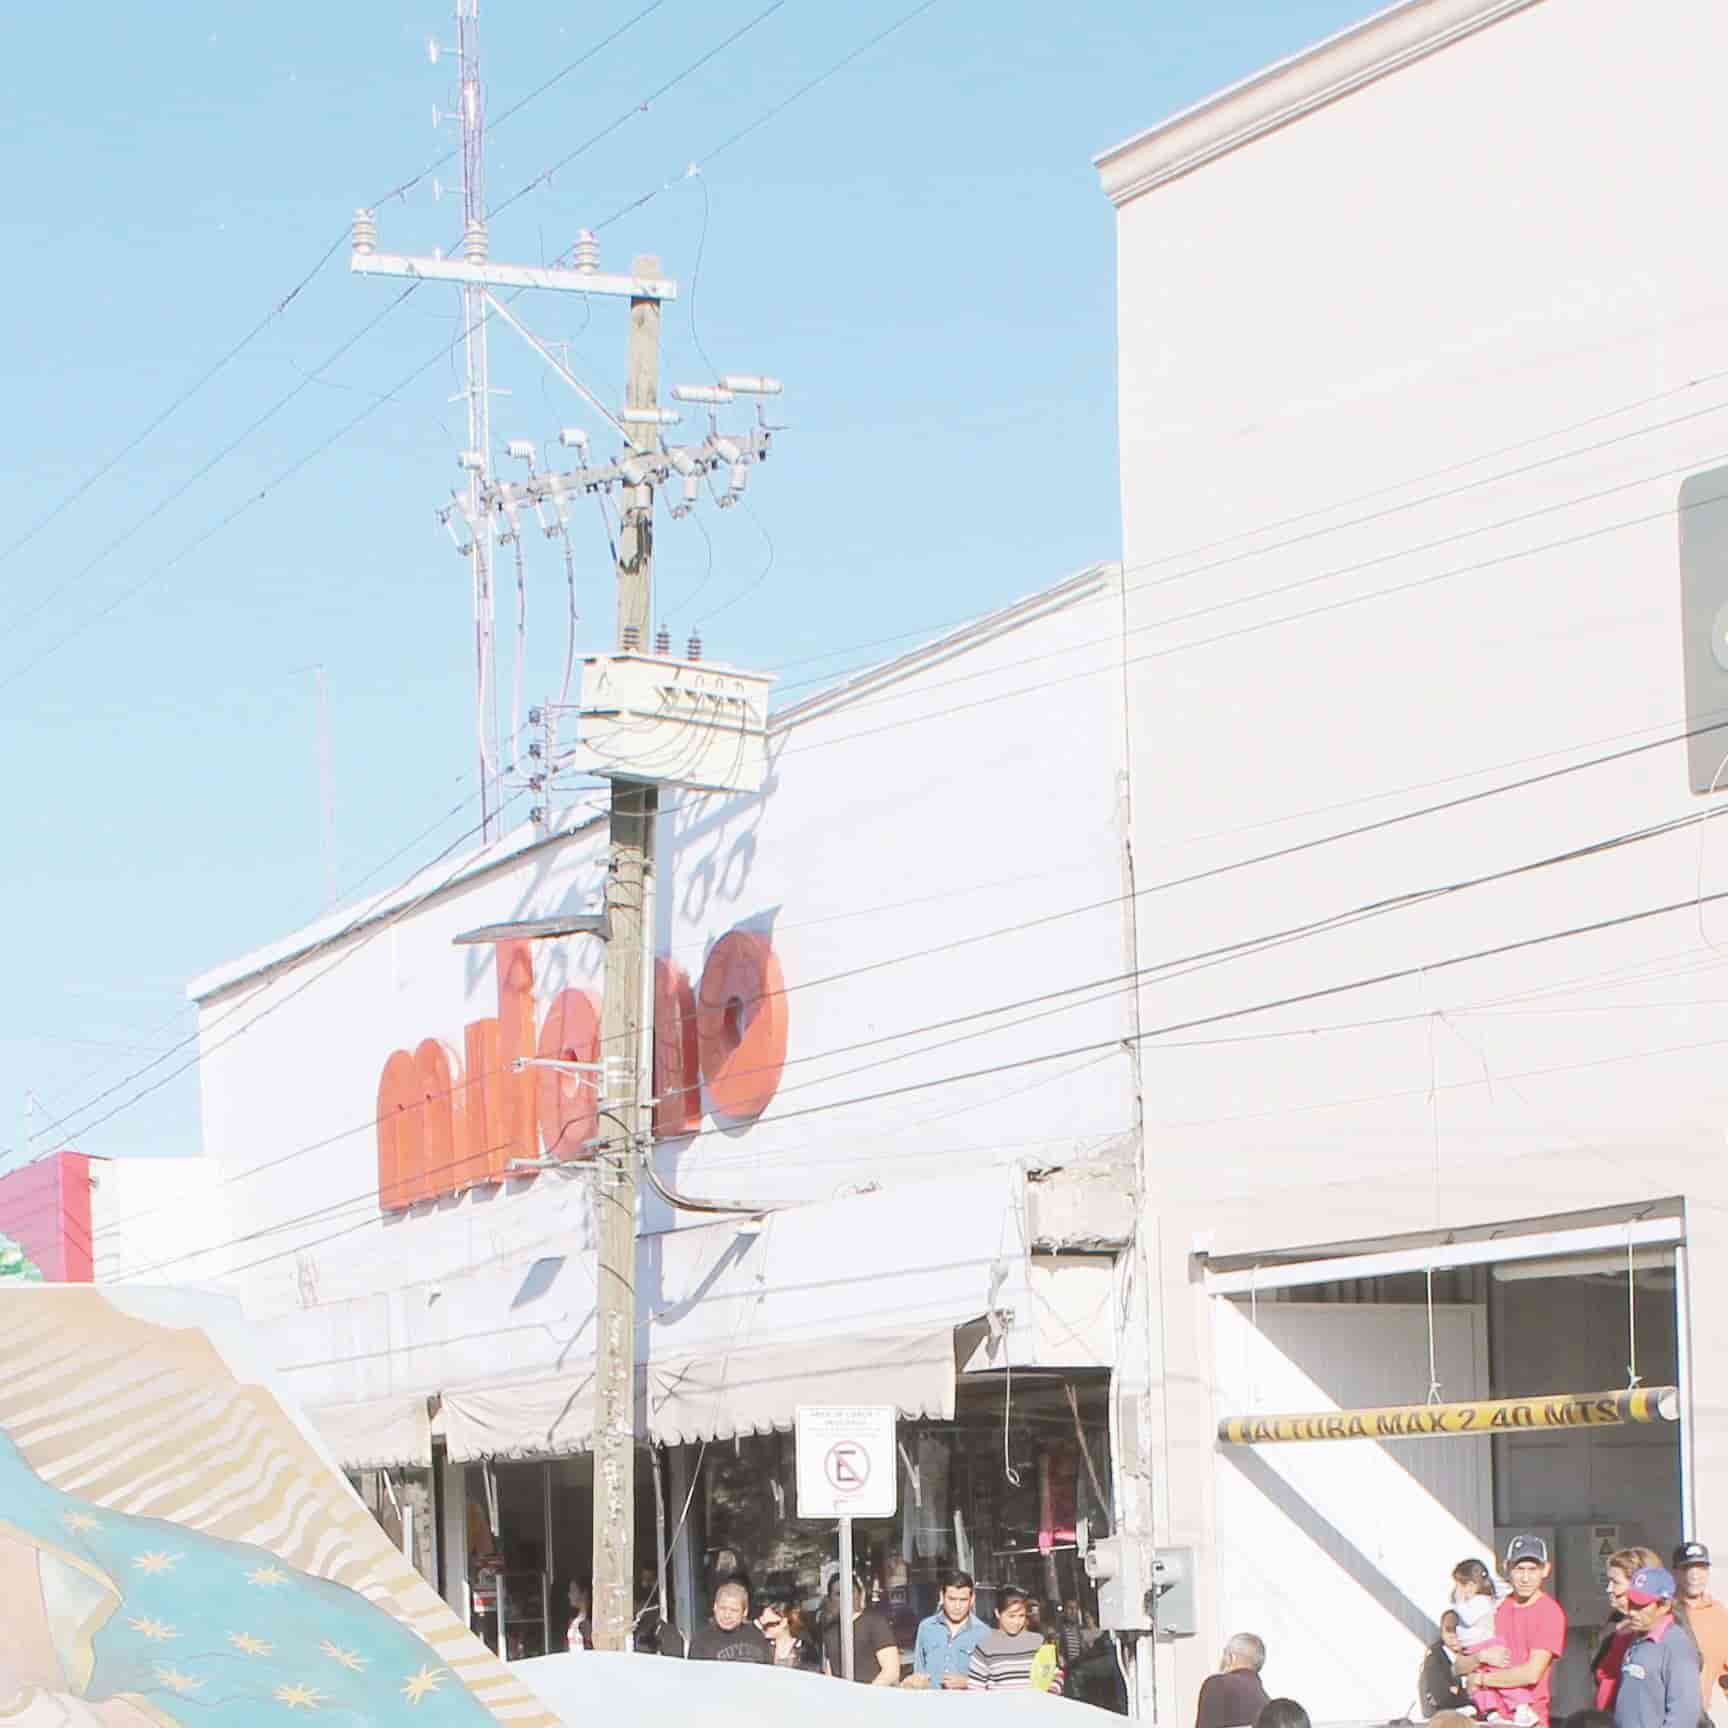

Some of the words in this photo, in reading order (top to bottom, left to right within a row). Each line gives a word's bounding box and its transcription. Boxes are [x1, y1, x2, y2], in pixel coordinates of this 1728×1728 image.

[1252, 1415, 1368, 1443] ALTURA
[1376, 1409, 1450, 1436] MAX
[1545, 1398, 1620, 1427] MTS
